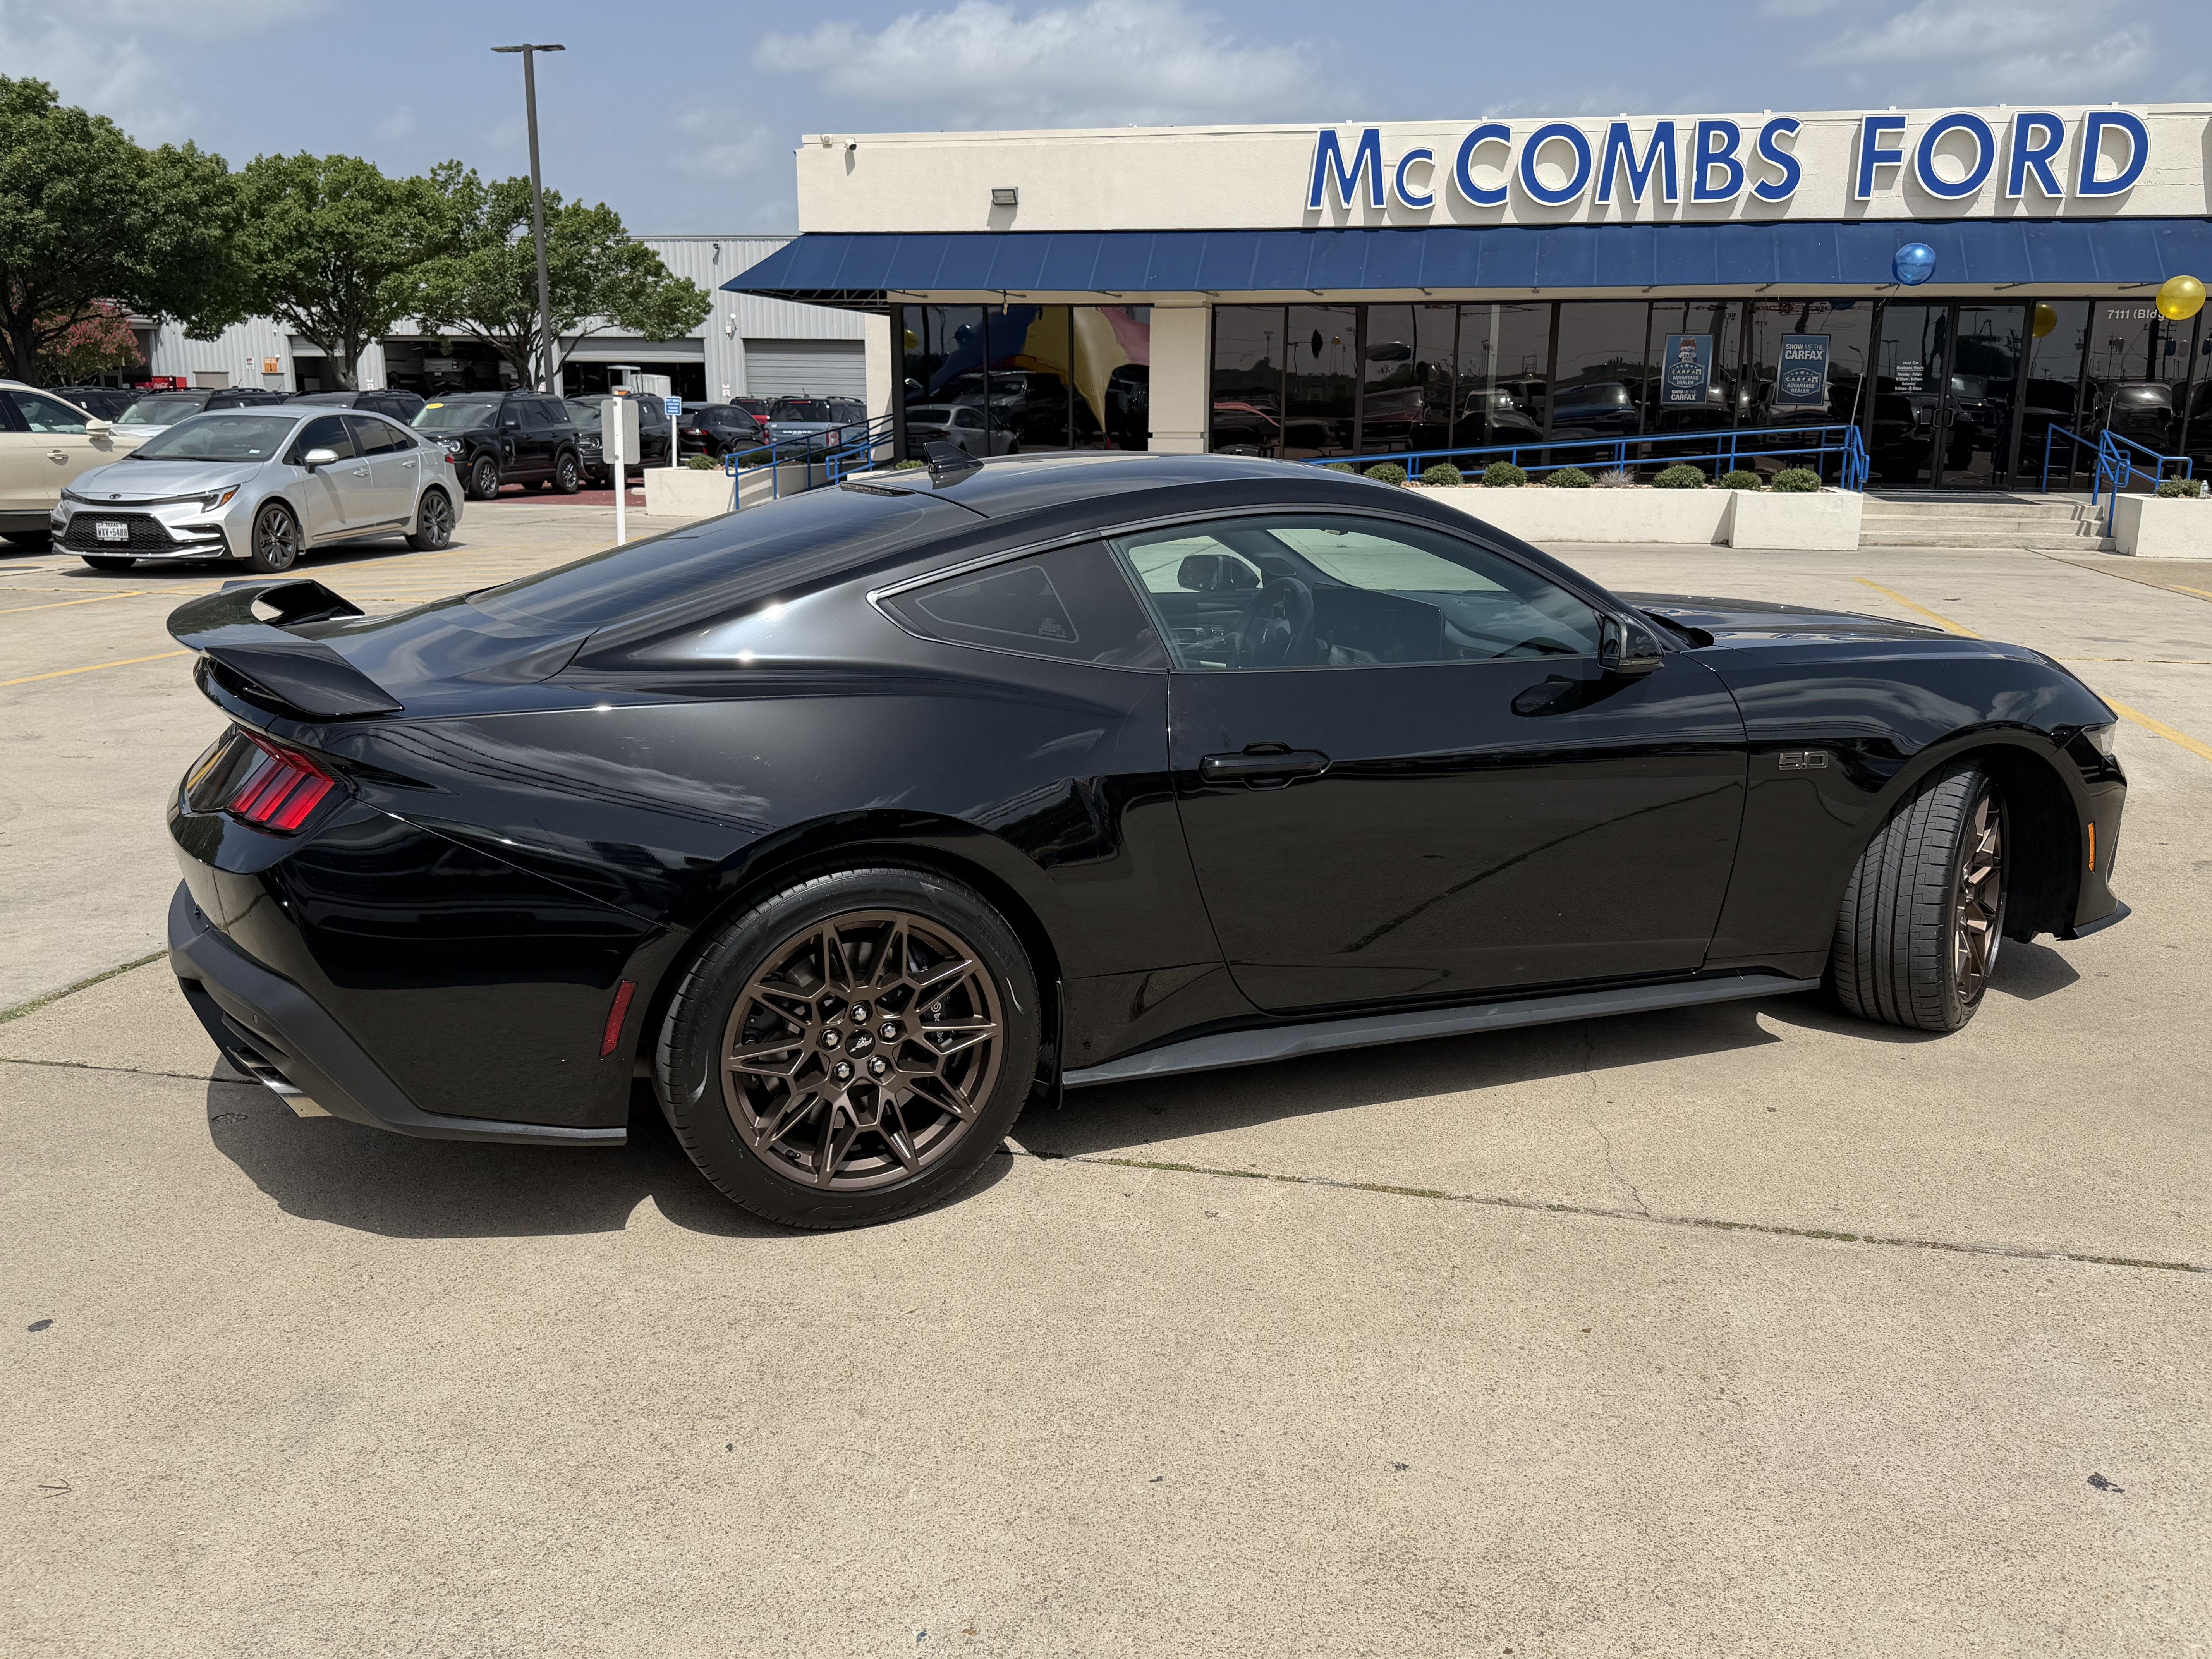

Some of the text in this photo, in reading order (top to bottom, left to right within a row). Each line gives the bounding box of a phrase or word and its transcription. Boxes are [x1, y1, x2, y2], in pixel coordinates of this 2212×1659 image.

[1854, 110, 2151, 200] FORD
[2108, 309, 2130, 319] 7111
[1785, 350, 1825, 360] CARFAX
[1779, 751, 1828, 770] 5.0
